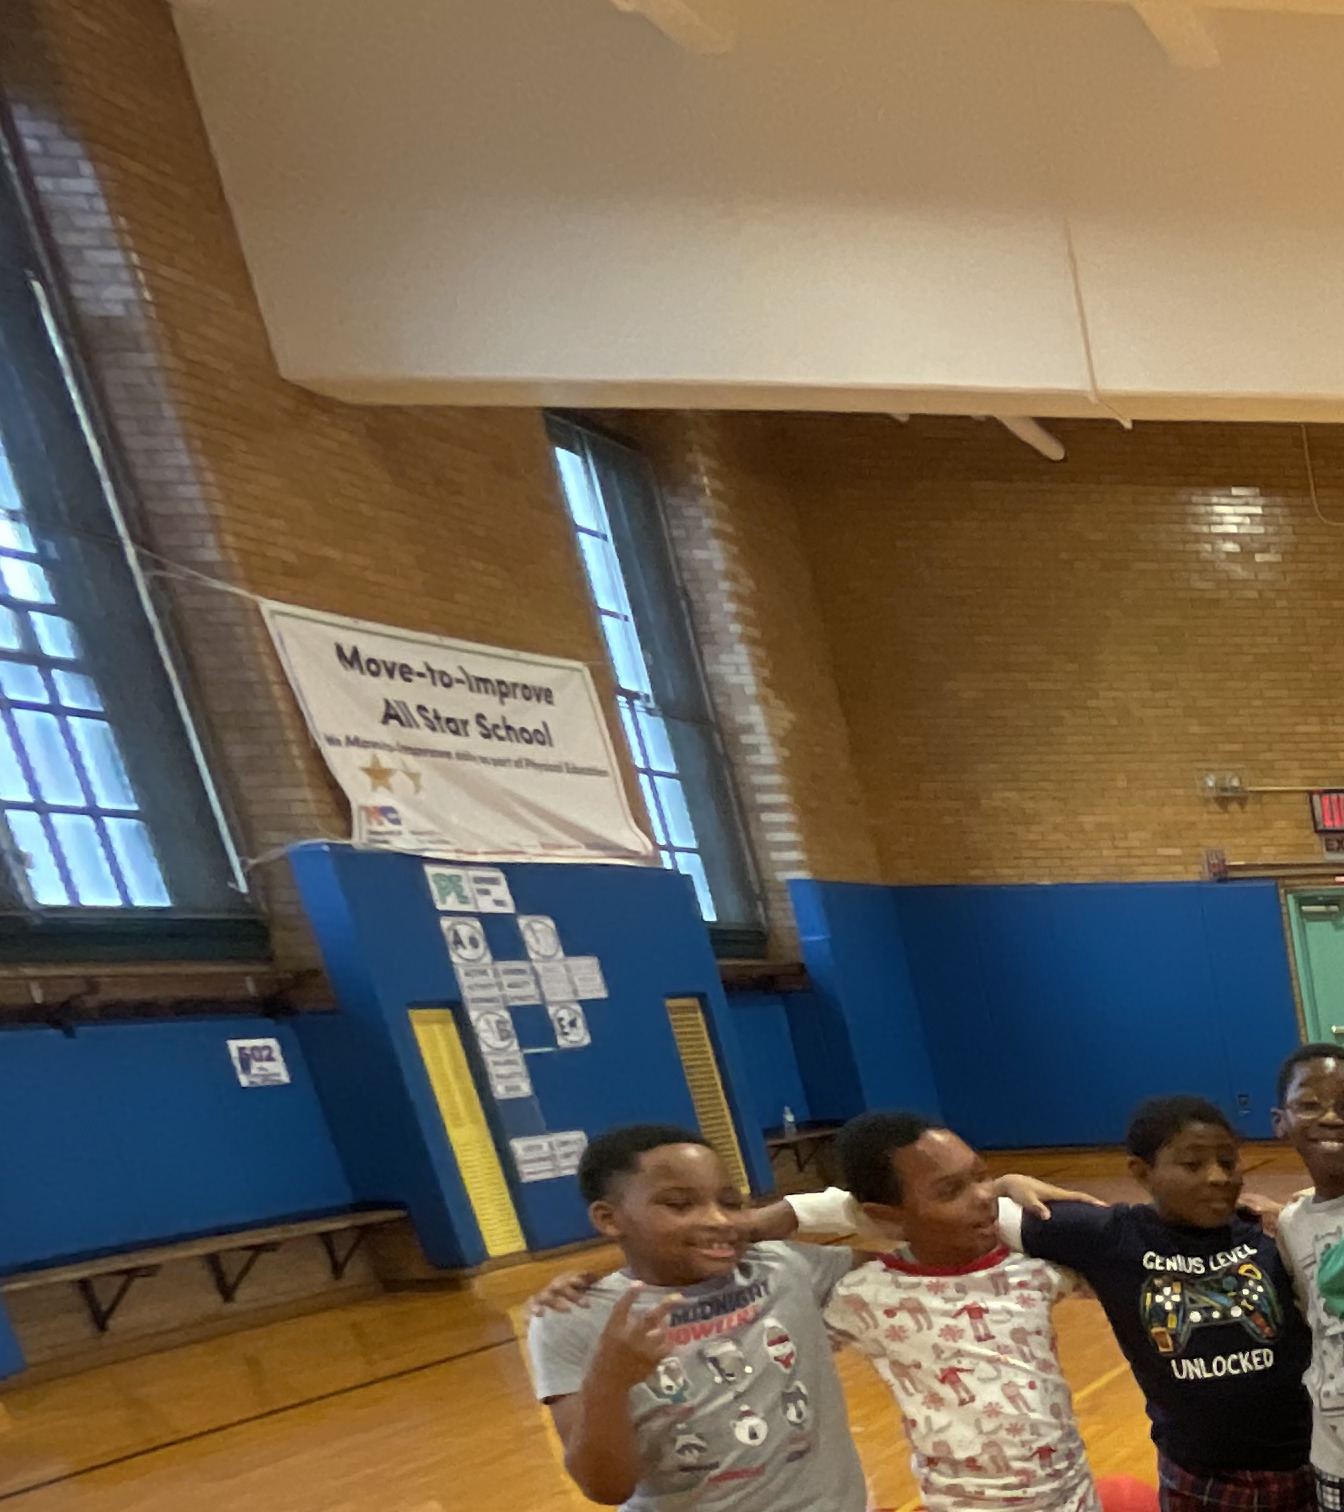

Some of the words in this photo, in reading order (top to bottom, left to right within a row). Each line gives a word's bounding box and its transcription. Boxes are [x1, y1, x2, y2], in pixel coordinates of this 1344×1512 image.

[335, 642, 554, 705] Move-to-Improve
[381, 698, 420, 729] All
[416, 704, 470, 737] Star
[475, 713, 554, 747] School
[432, 873, 470, 905] PE
[1143, 1251, 1206, 1275] GENIUS
[1209, 1243, 1258, 1272] LEVEL
[1171, 1348, 1274, 1380] UNLOCKED
